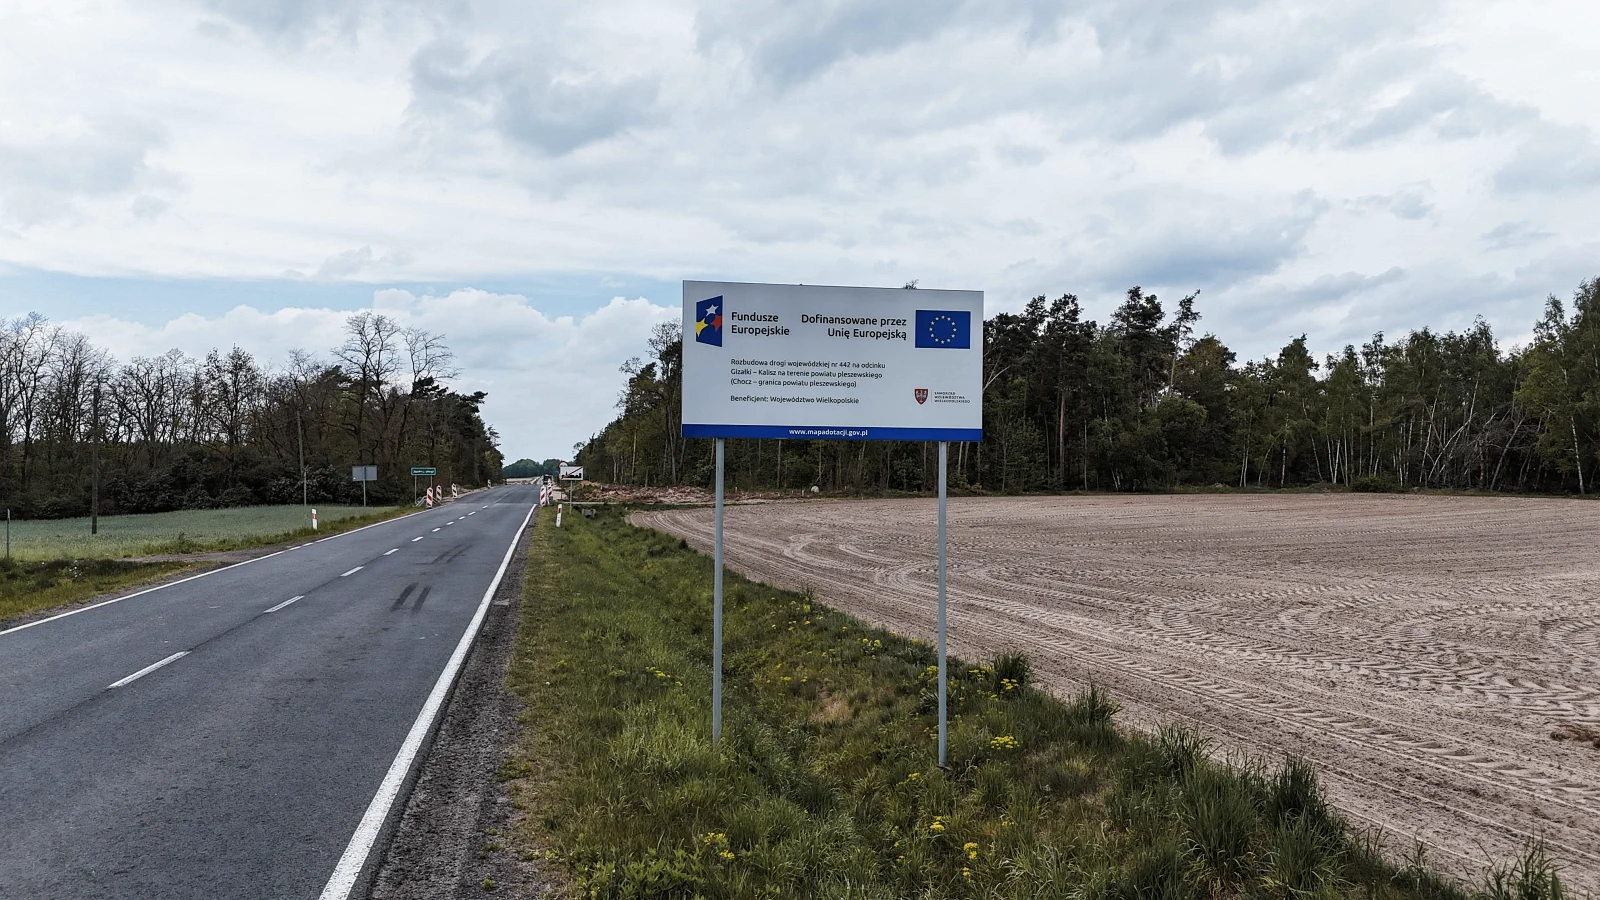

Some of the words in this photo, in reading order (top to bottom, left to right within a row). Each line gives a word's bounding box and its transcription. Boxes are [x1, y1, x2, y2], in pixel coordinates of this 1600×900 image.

[731, 311, 779, 323] Fundusze
[801, 313, 878, 325] Dofinansowane
[881, 318, 907, 327] przez
[731, 324, 790, 336] Europejskie
[828, 328, 850, 339] Unię
[853, 328, 907, 340] Europejską
[731, 358, 768, 366] Rozbudowa
[787, 360, 829, 369] wojewódzkiej
[731, 368, 752, 376] Gizałki
[811, 370, 836, 378] powiatu
[838, 371, 883, 379] pleszewskiego
[731, 378, 752, 386] (Chocz
[758, 379, 781, 387] granica
[810, 380, 857, 389] pleszewskiego)
[731, 395, 768, 403] Beneficjent:
[770, 396, 814, 404] Województwo
[816, 397, 860, 405] Wielkopolskie
[789, 429, 868, 437] www.mapadotacji.gov.pl
